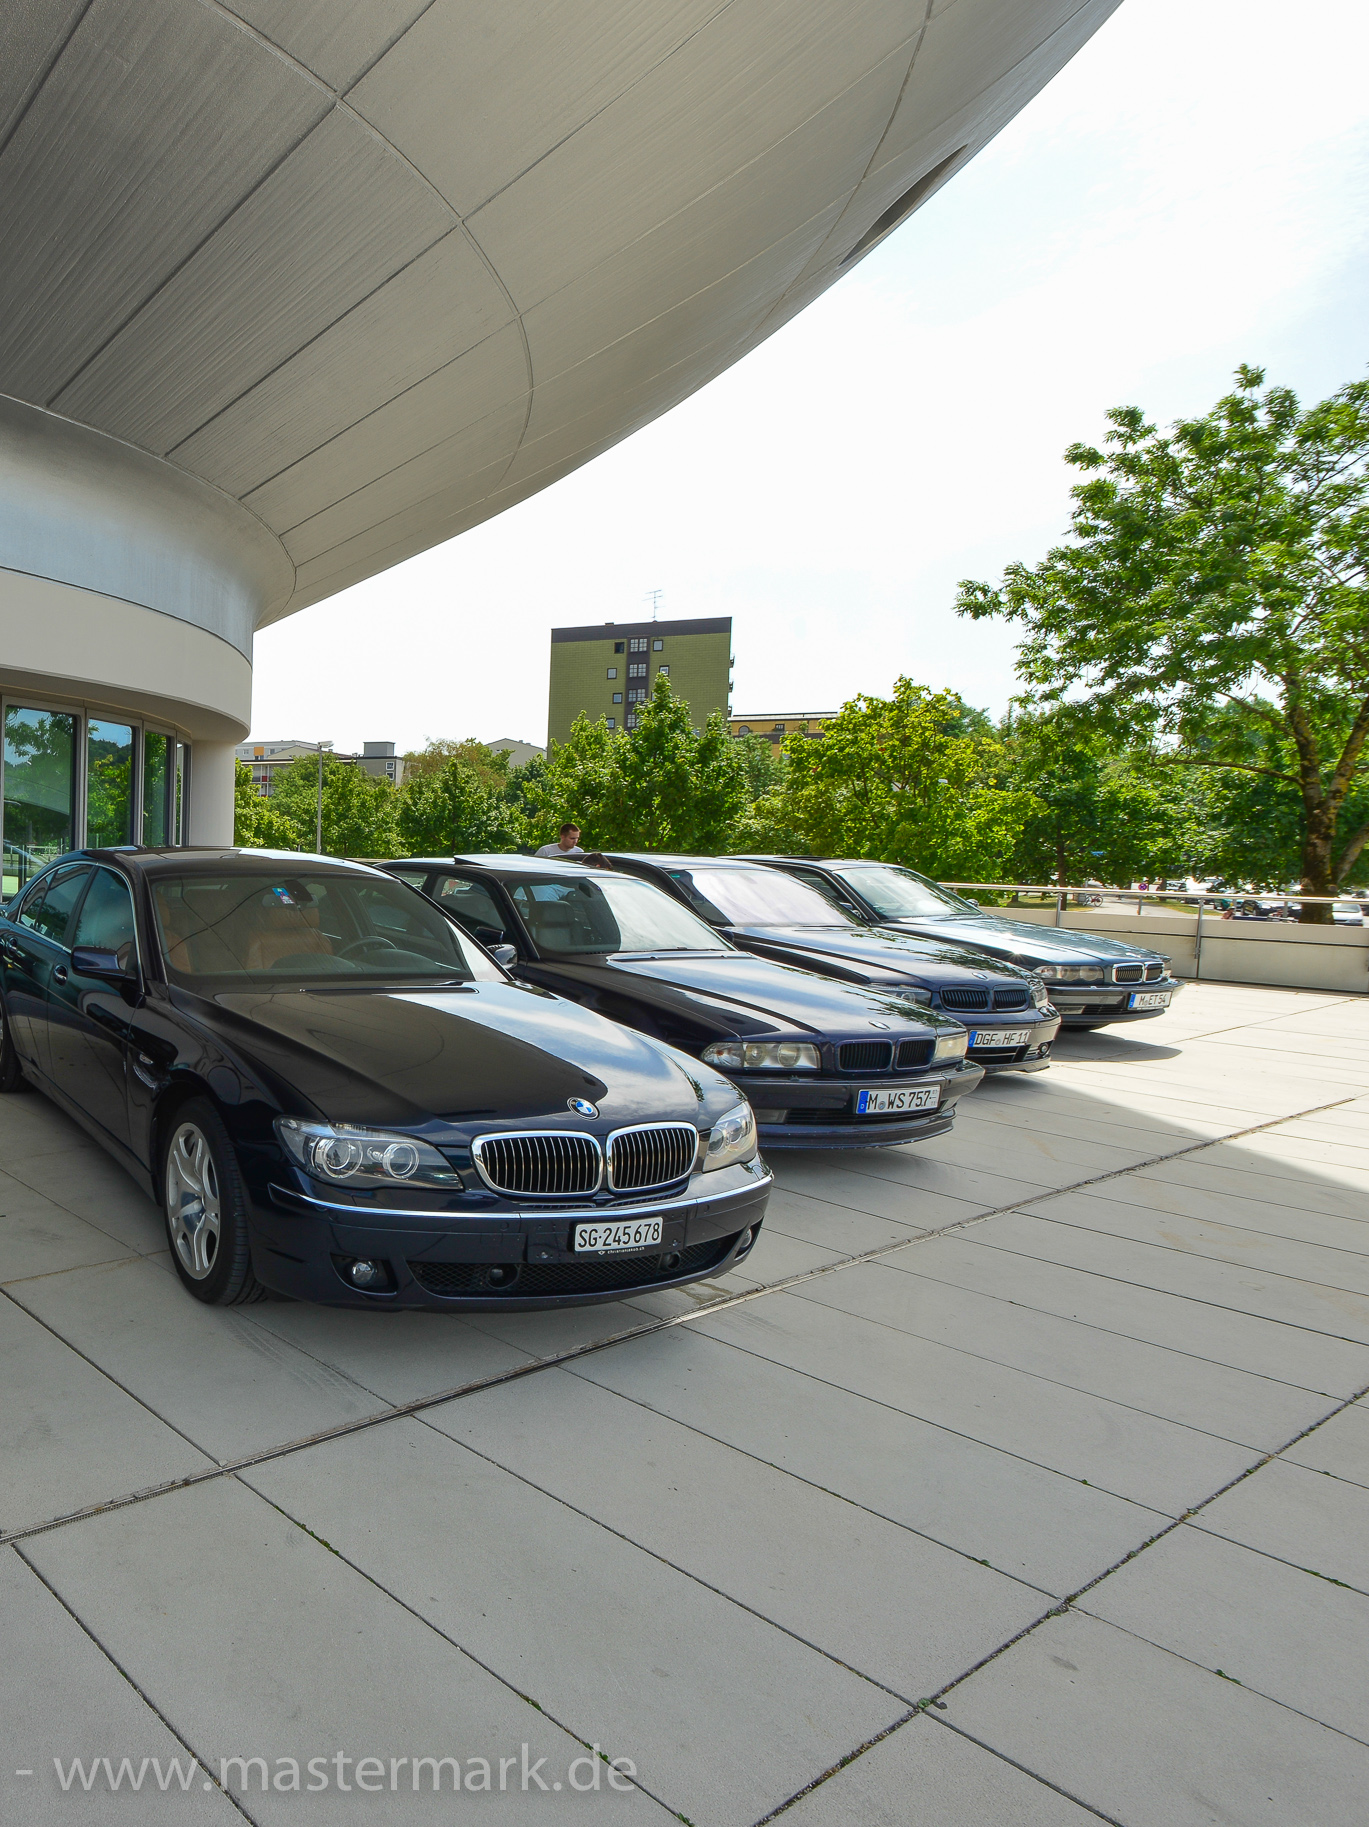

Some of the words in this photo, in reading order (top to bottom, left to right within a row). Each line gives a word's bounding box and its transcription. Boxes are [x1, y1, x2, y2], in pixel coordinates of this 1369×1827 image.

[974, 1033, 998, 1045] DGF
[1002, 1033, 1017, 1045] HF
[867, 1093, 879, 1110] M
[887, 1092, 905, 1109] WS
[908, 1090, 931, 1108] 757
